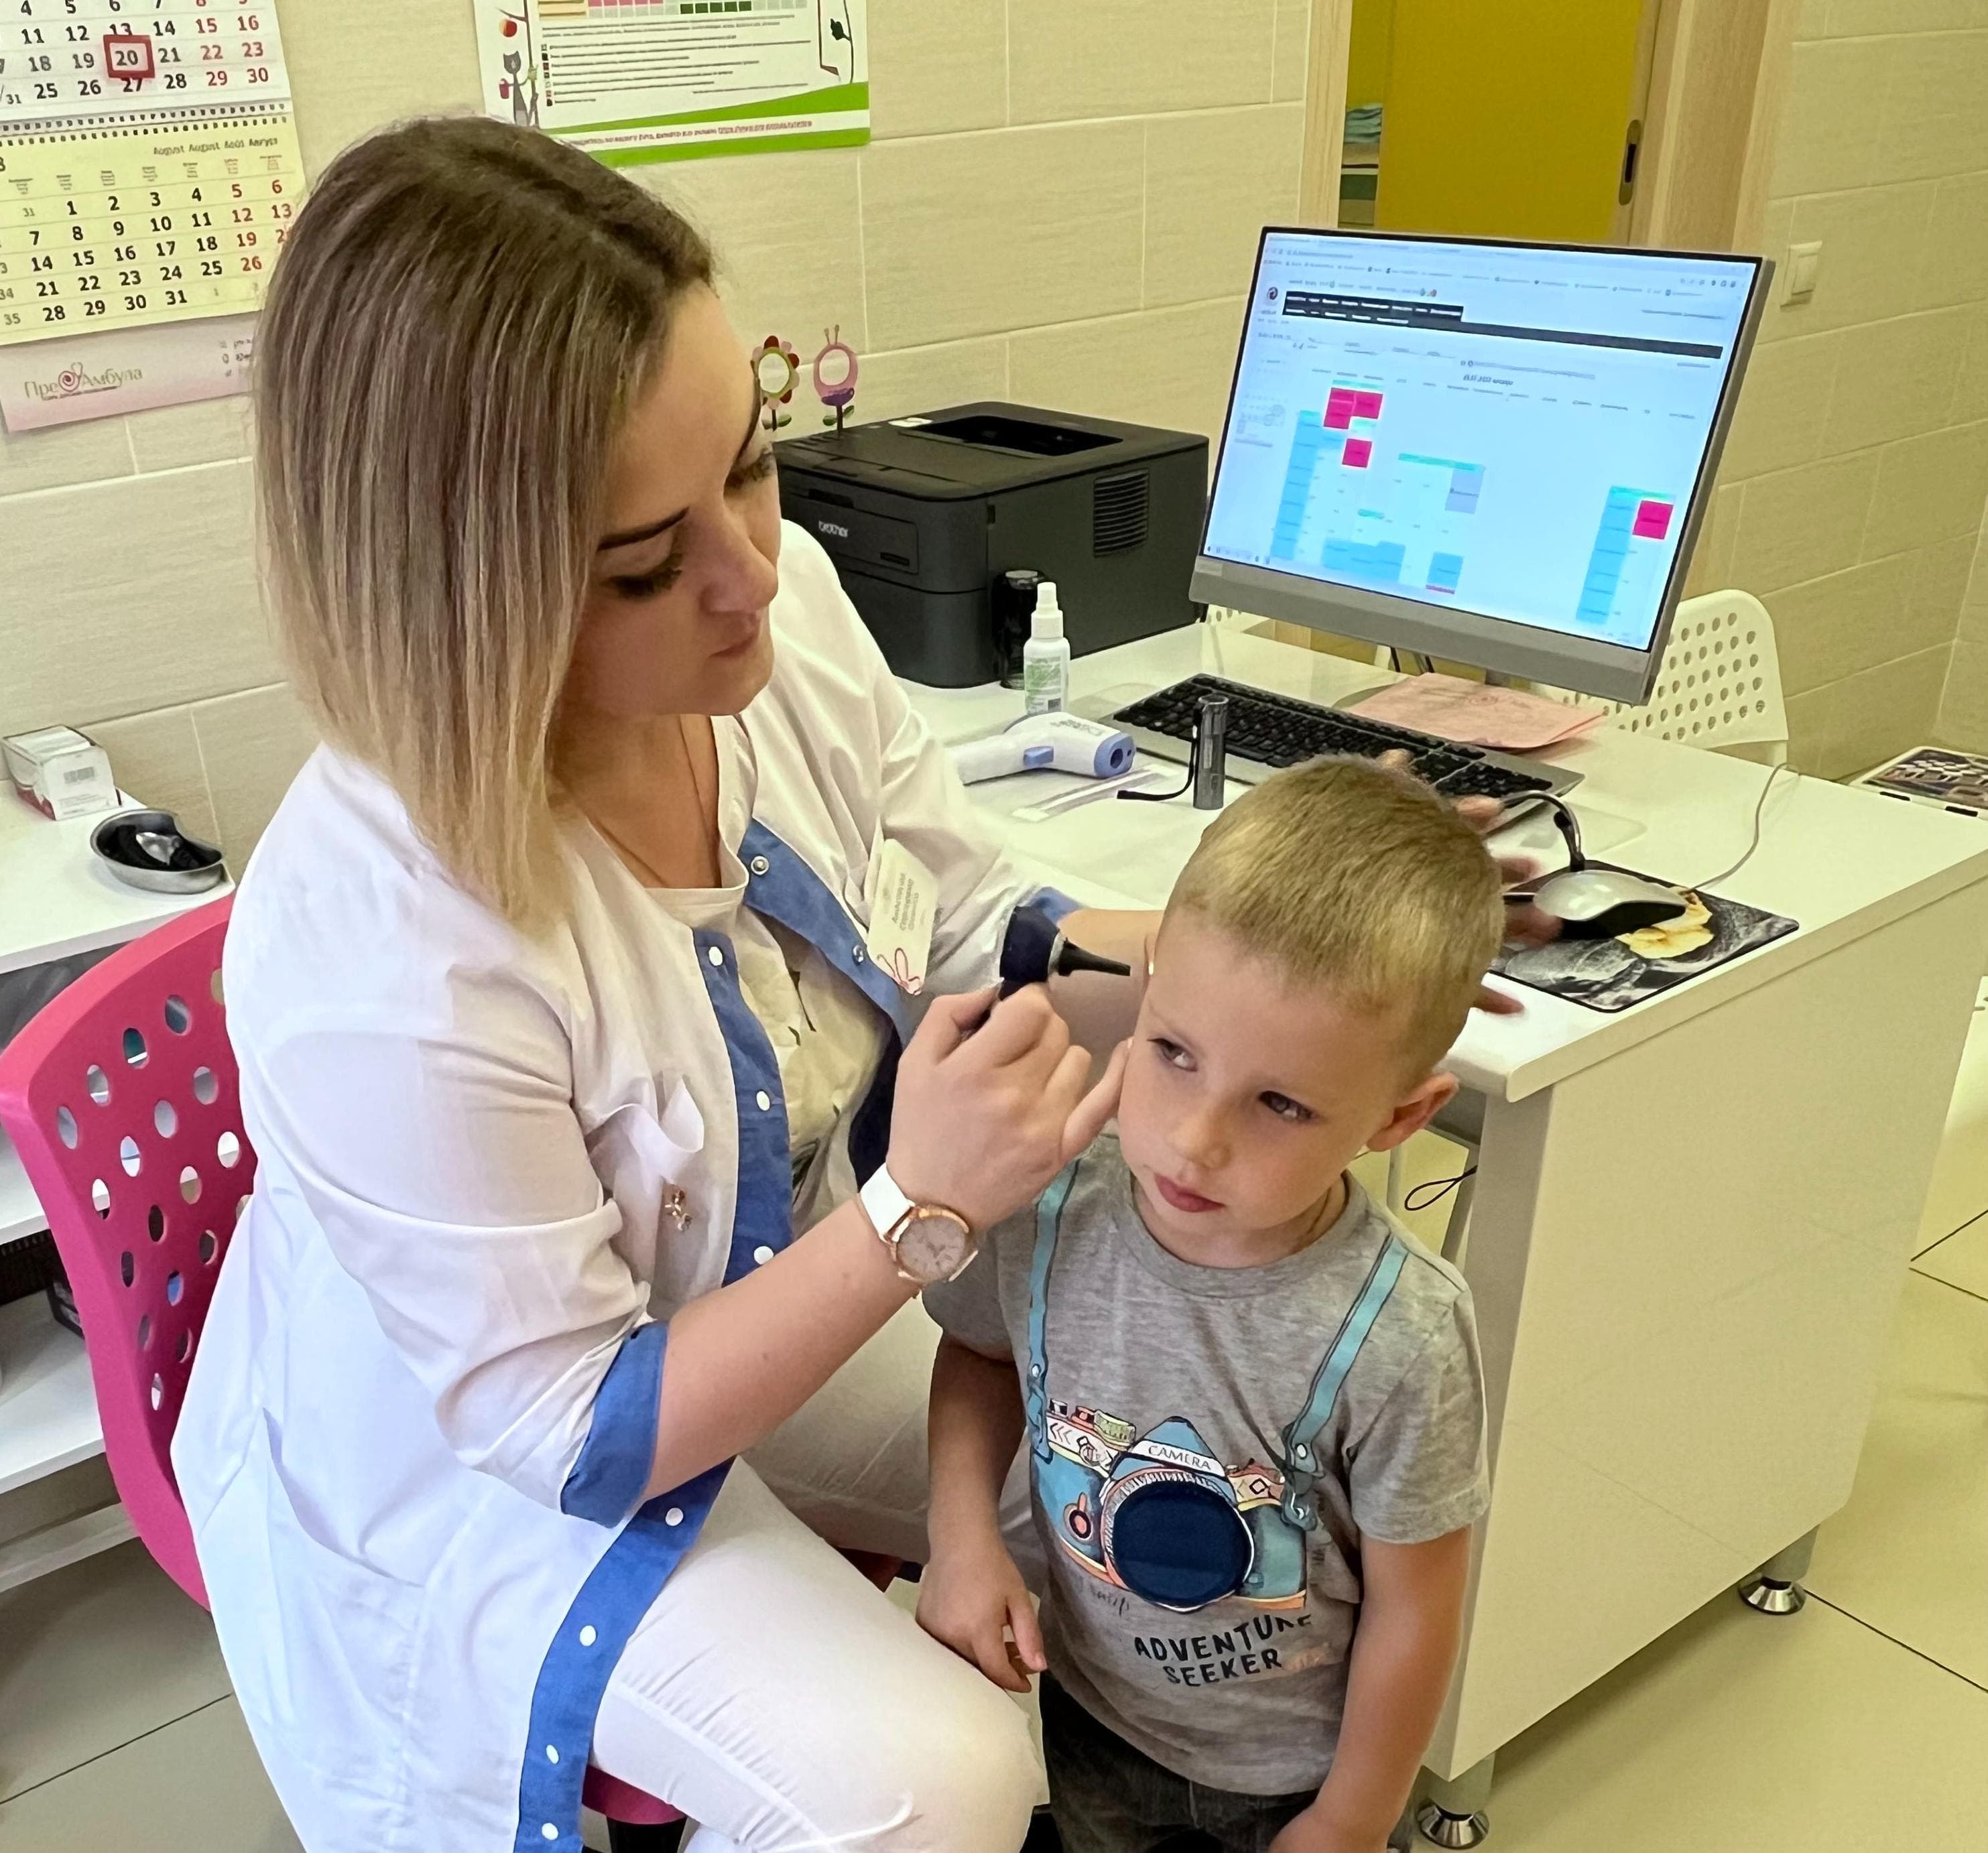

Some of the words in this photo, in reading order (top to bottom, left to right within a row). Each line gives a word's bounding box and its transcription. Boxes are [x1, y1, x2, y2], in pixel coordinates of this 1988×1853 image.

[21, 0, 32, 15] 4
[66, 0, 76, 13] 5
[109, 0, 121, 11] 6
[21, 28, 44, 44] 11
[66, 25, 90, 42] 12
[153, 21, 176, 36] 14
[196, 17, 217, 34] 15
[237, 15, 259, 31] 16
[28, 56, 52, 72] 18
[72, 53, 95, 69] 19
[115, 50, 139, 66] 20
[158, 47, 181, 63] 21
[200, 45, 223, 60] 22
[242, 42, 263, 57] 23
[34, 83, 58, 99] 25
[77, 80, 101, 96] 26
[121, 78, 143, 92] 27
[164, 73, 187, 89] 28
[206, 70, 228, 86] 29
[247, 67, 269, 83] 30
[23, 207, 35, 217] 31
[66, 200, 78, 215] 1
[108, 196, 120, 211] 2
[149, 192, 161, 206] 3
[191, 187, 202, 202] 4
[231, 183, 243, 198] 5
[271, 180, 283, 194] 6
[29, 231, 40, 245] 7
[72, 226, 84, 241] 8
[113, 221, 125, 236] 9
[150, 216, 172, 232] 10
[192, 212, 212, 227] 11
[232, 208, 253, 222] 12
[271, 203, 292, 219] 13
[31, 255, 53, 272] 14
[72, 250, 95, 266] 15
[114, 245, 136, 261] 16
[156, 241, 176, 256] 17
[196, 236, 218, 252] 18
[237, 231, 257, 247] 19
[275, 229, 288, 244] 2
[36, 281, 59, 297] 21
[78, 275, 101, 291] 22
[119, 270, 141, 286] 23
[160, 265, 182, 281] 24
[201, 260, 223, 276] 25
[241, 256, 262, 271] 26
[3, 313, 21, 325] 35
[42, 305, 66, 322] 28
[84, 300, 105, 316] 29
[124, 295, 147, 310] 30
[165, 290, 188, 305] 31
[1148, 1446, 1211, 1470] CAMERA
[1163, 1648, 1283, 1687] SEEKER
